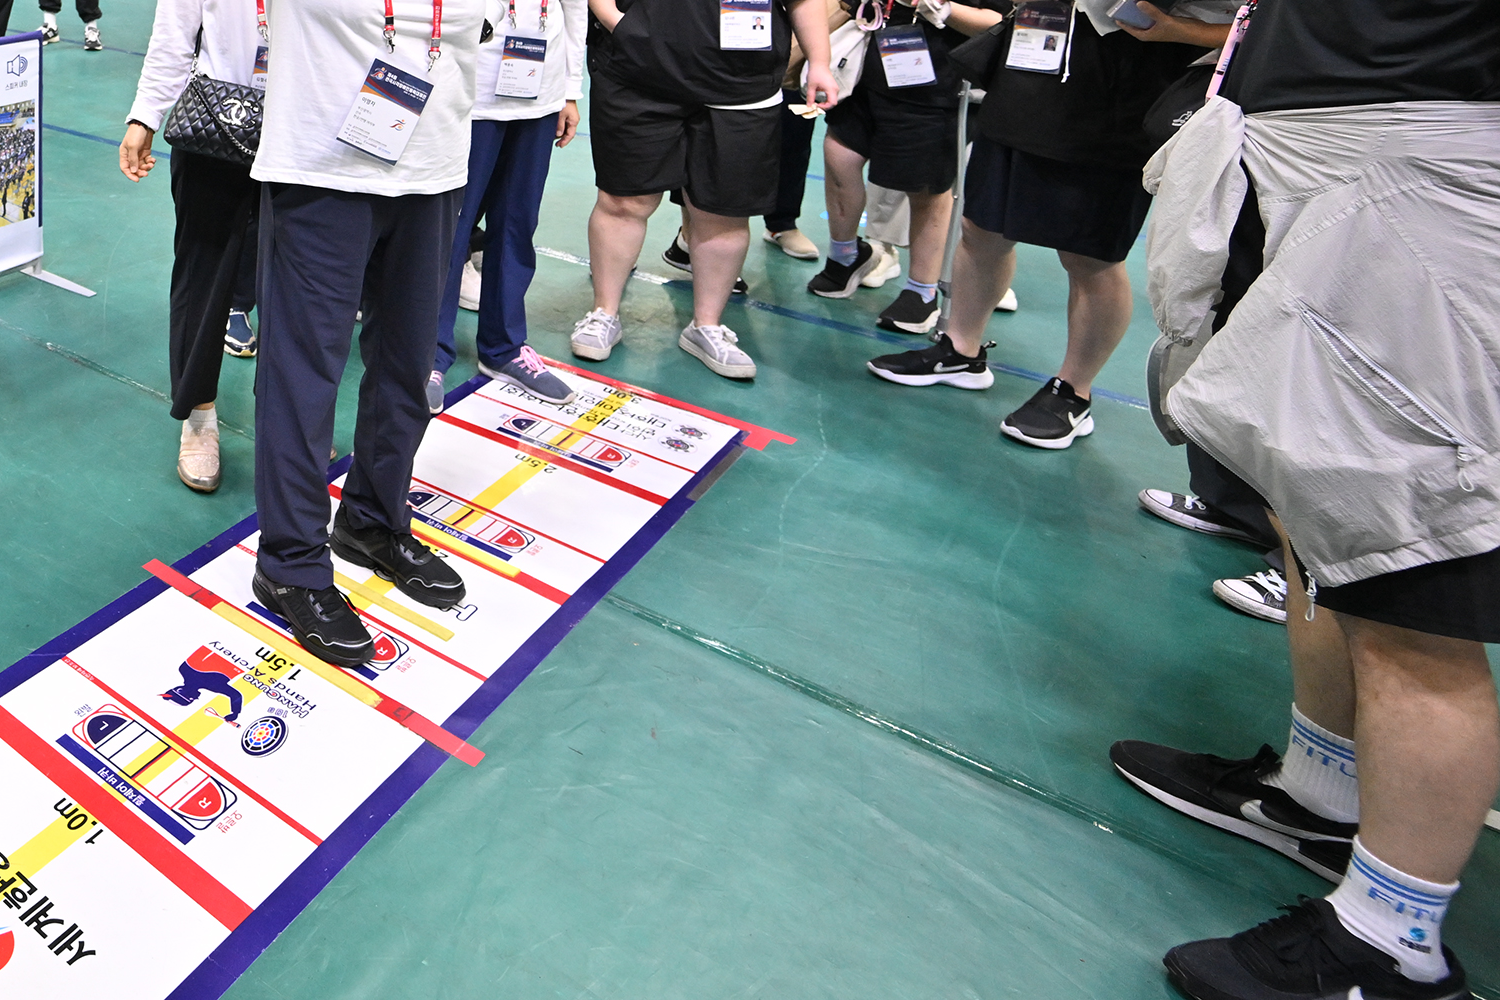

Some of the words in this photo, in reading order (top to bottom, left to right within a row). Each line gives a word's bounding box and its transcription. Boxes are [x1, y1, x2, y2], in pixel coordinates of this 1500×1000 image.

[5, 82, 17, 91] 스피커
[603, 387, 642, 405] 3.0m
[514, 453, 558, 474] 2.5m
[374, 646, 388, 656] R
[208, 640, 270, 686] Archery
[254, 645, 302, 682] 1.5m
[268, 676, 318, 712] Hands
[98, 720, 109, 732] L
[98, 766, 120, 786] 바퀴
[118, 784, 147, 807] 휠체어
[197, 796, 213, 809] R
[53, 797, 104, 845] 1.0m
